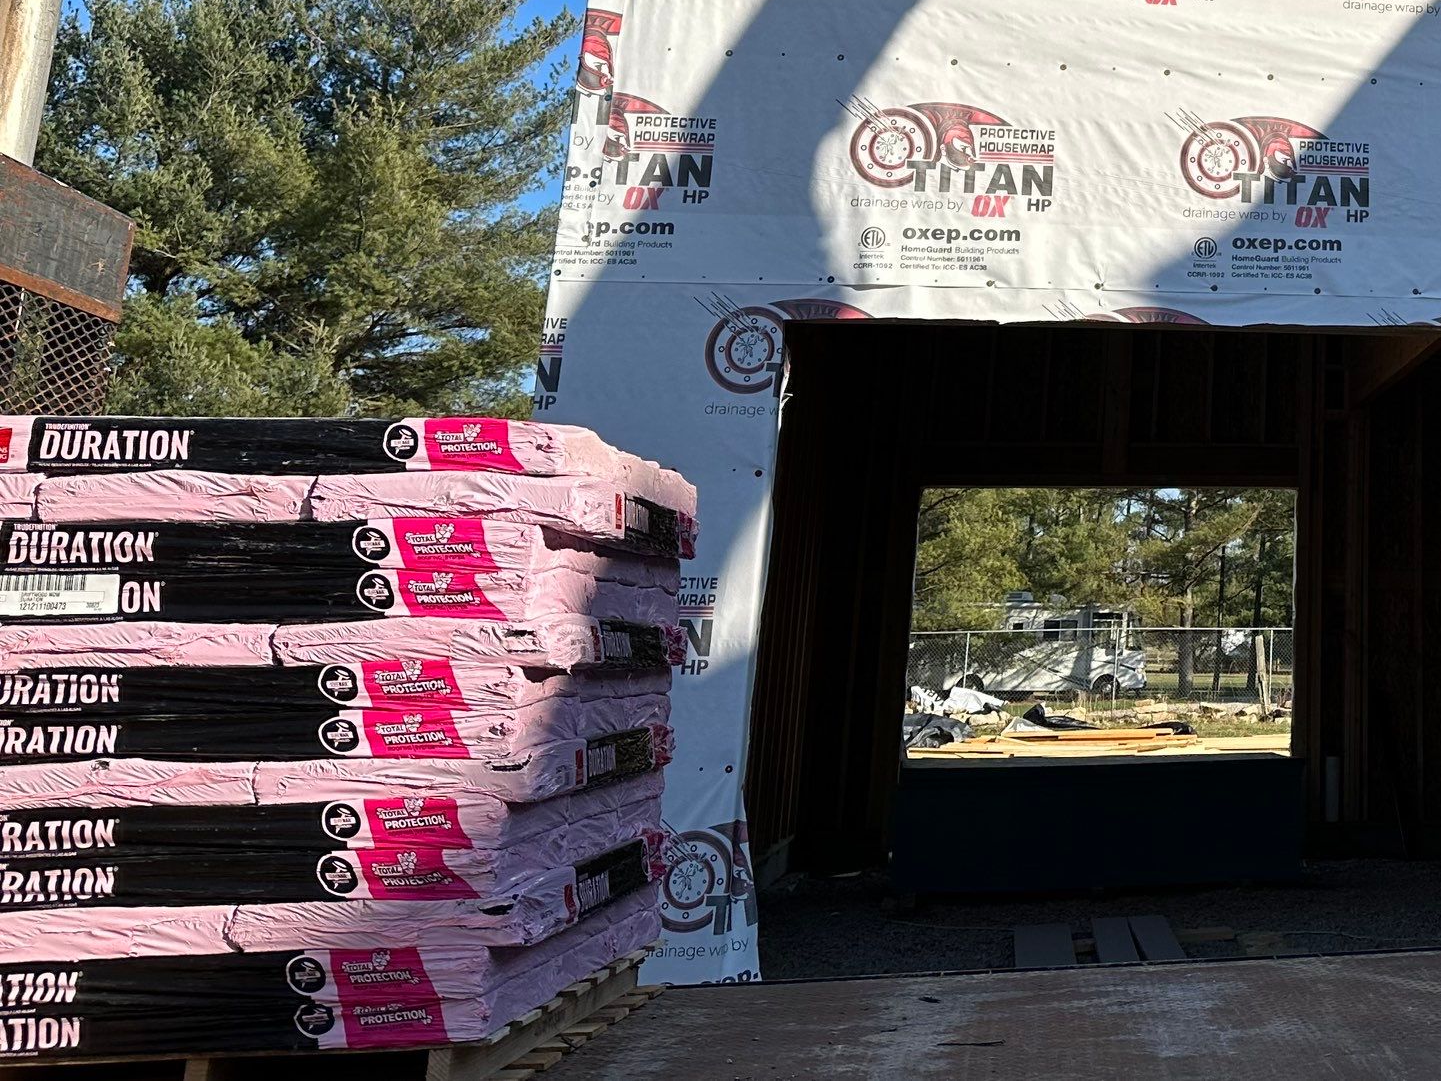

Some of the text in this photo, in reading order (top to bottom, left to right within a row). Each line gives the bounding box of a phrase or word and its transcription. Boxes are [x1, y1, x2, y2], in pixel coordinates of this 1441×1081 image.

[1342, 0, 1393, 13] drainage
[1395, 3, 1424, 15] wrap
[1427, 2, 1440, 17] by
[980, 126, 1055, 141] PROTECTIVE
[979, 141, 1054, 155] HOUSEWRAP
[906, 161, 1053, 196] TITAN
[850, 195, 1052, 218] drainage wrap by OX HP
[903, 228, 1020, 243] oxep.com
[955, 247, 984, 255] Building
[40, 430, 189, 460] DURATION
[441, 442, 497, 452] PROTECTION
[412, 535, 434, 543] TOTAL
[7, 532, 155, 564] DURATION
[414, 544, 473, 554] PROTECTION
[381, 673, 404, 681] TOTAL
[0, 674, 119, 705] URATION
[382, 680, 445, 694] PROTECTION
[0, 725, 118, 754] RATION
[385, 815, 445, 829] PROTECTION
[2, 819, 115, 851] RATION
[1, 867, 115, 903] RATION
[350, 971, 412, 983] PROTECTION
